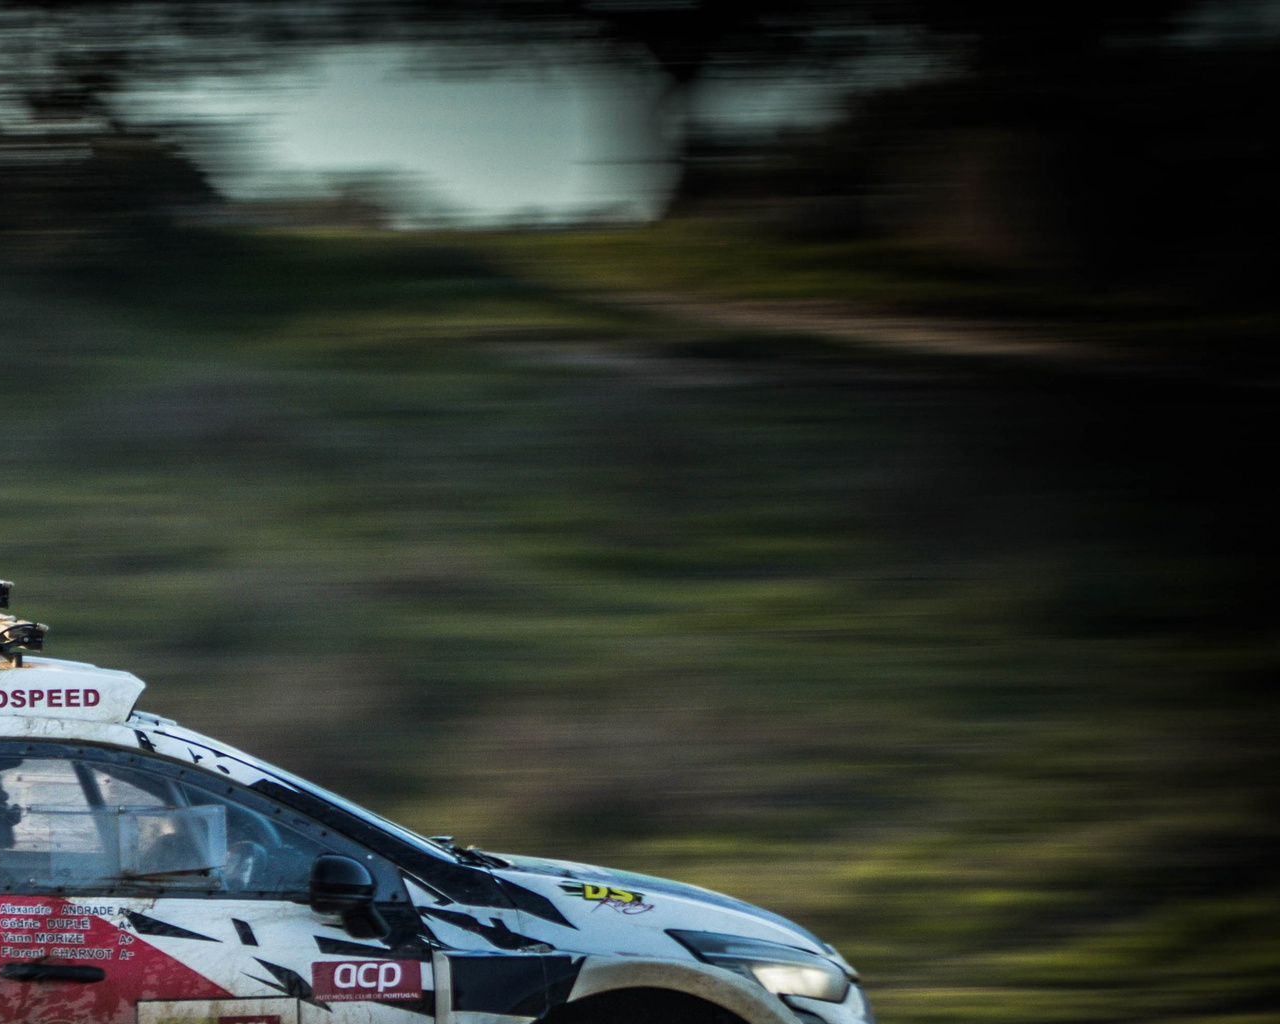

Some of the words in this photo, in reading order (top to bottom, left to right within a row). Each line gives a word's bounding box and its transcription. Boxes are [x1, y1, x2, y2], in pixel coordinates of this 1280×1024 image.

[0, 903, 52, 915] Alexandre
[61, 905, 114, 916] ANDRADE
[0, 918, 41, 929] Cédric
[47, 917, 91, 930] DUPLÉ
[118, 921, 132, 930] A+
[1, 932, 32, 944] Yann
[35, 933, 85, 944] MORIZE
[118, 934, 134, 946] A+
[1, 946, 45, 958] Florent
[50, 948, 113, 960] CHARVOT
[119, 949, 134, 961] A-
[333, 962, 402, 993] acp
